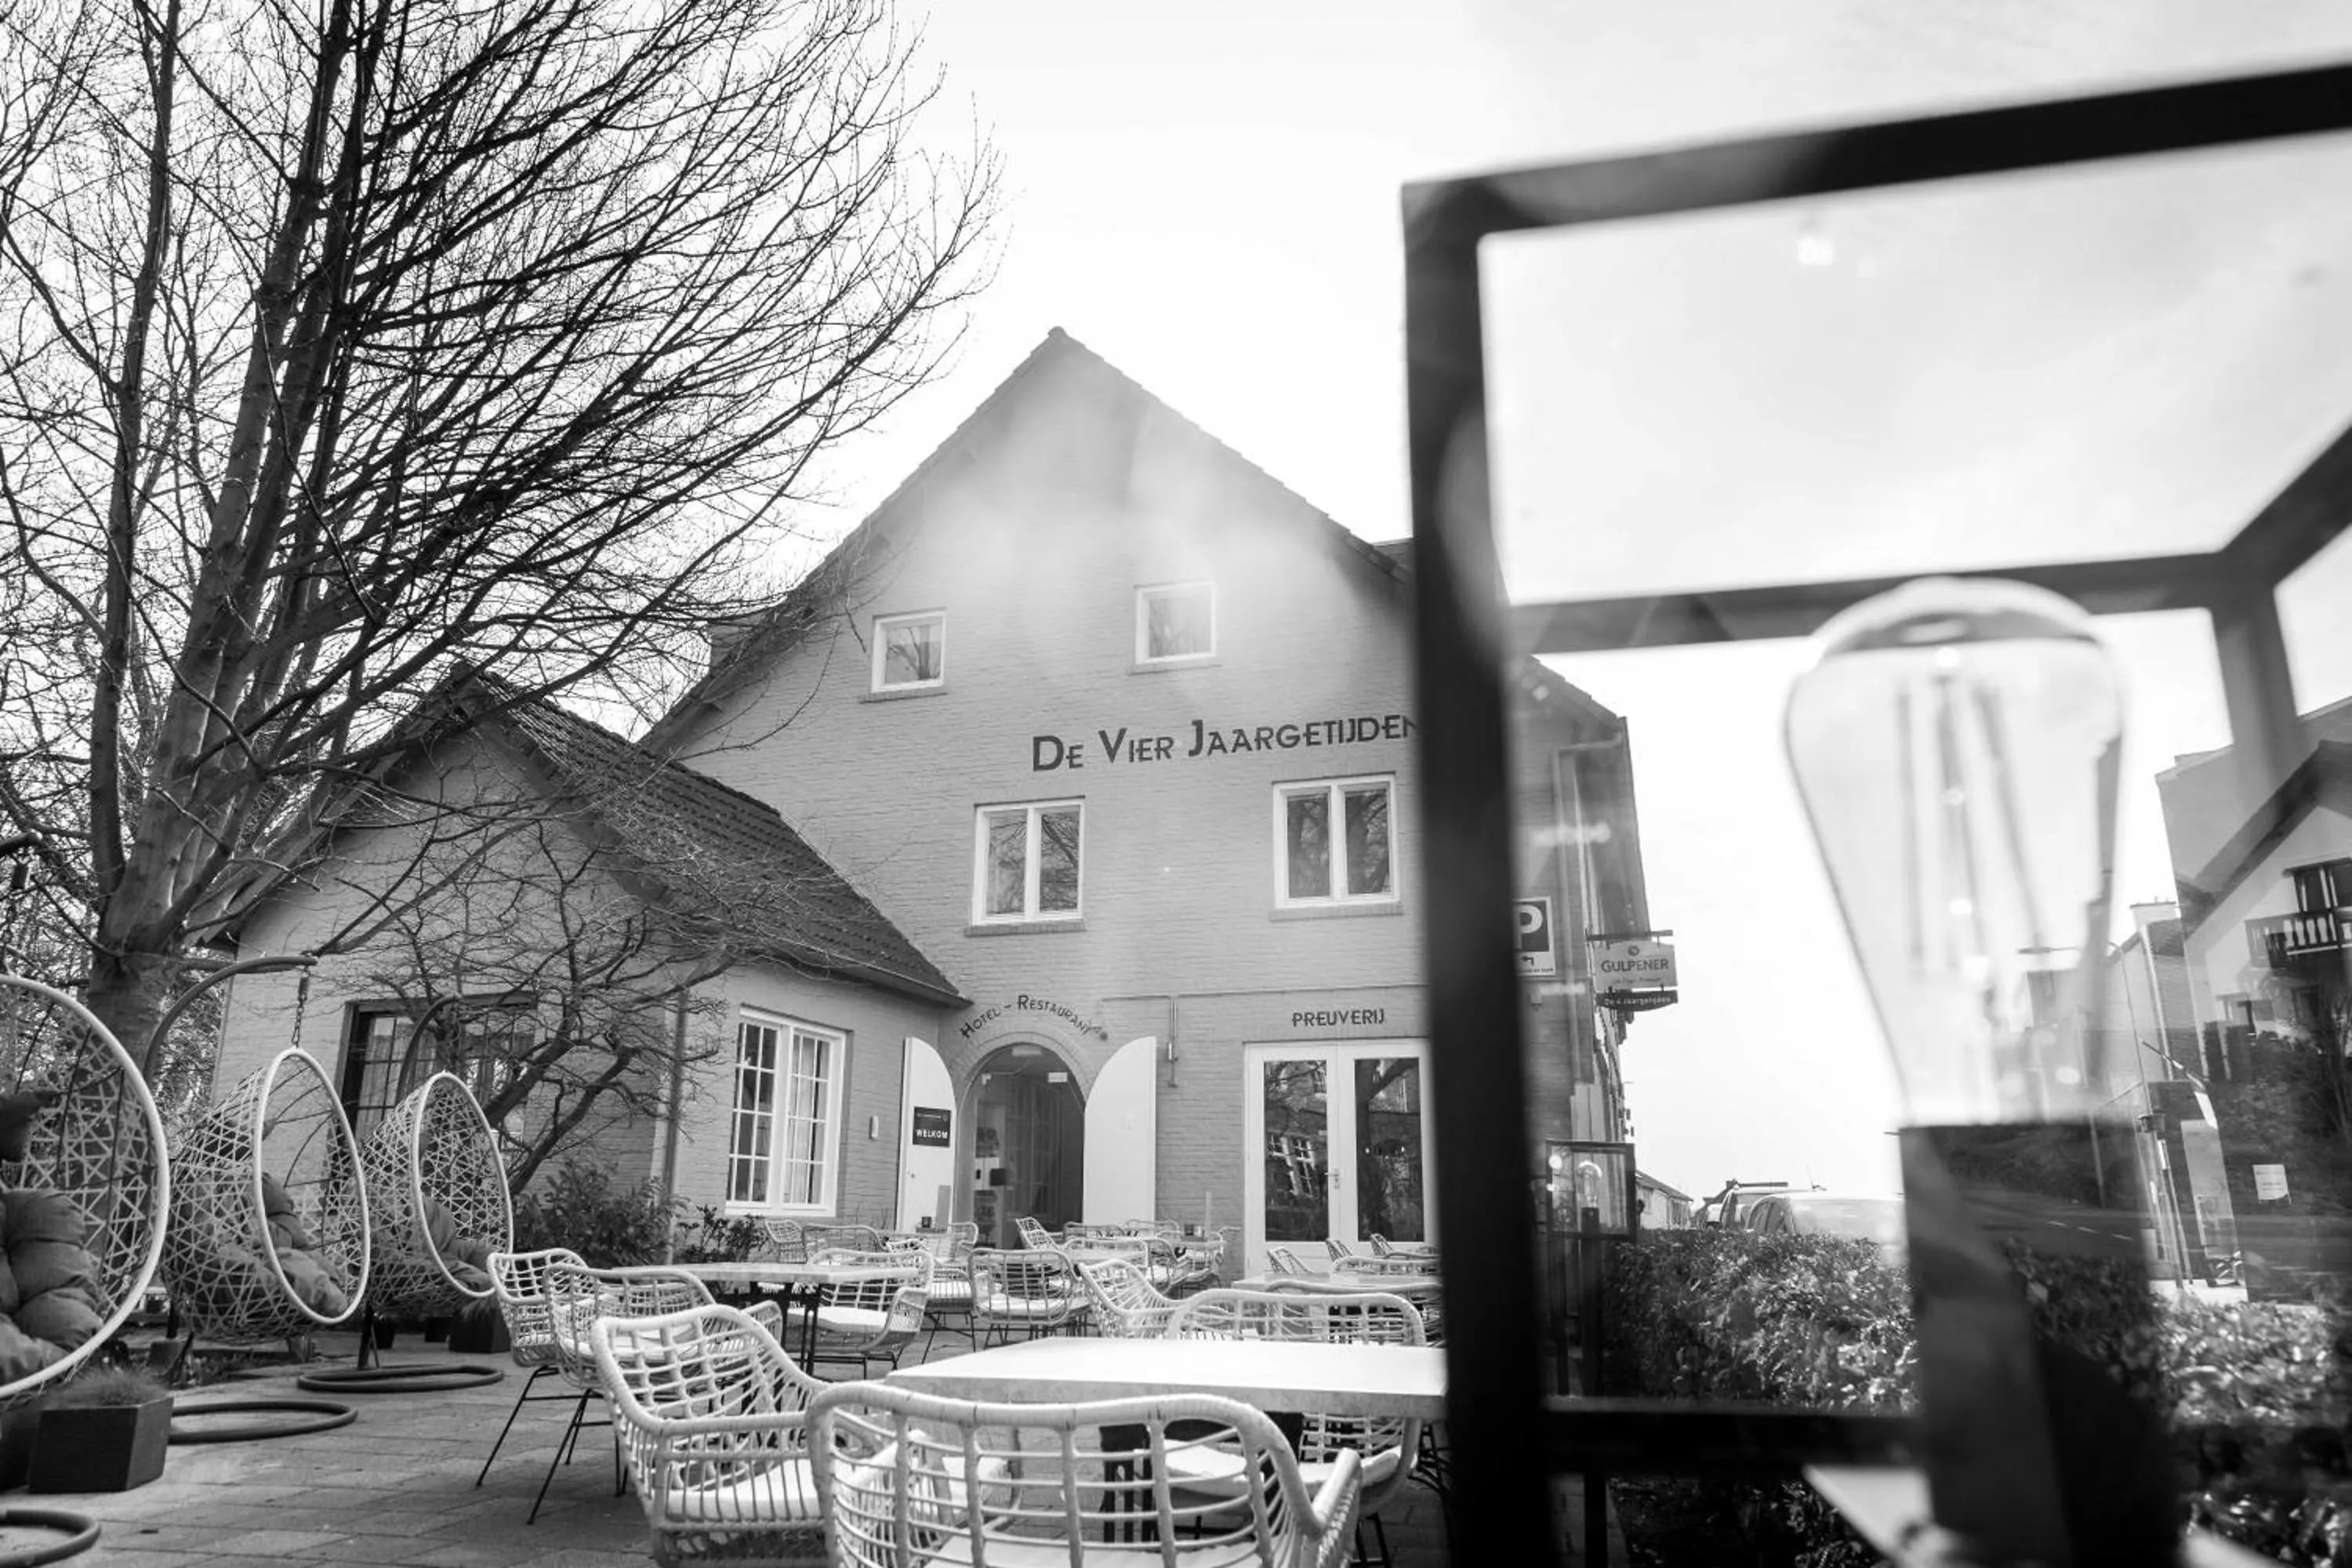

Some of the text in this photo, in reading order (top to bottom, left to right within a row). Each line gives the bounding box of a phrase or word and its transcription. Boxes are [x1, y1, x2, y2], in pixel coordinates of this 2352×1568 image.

[1514, 904, 1543, 949] P
[1601, 959, 1669, 972] GULPENER
[1292, 1008, 1385, 1028] PREUVERIJ
[916, 1129, 947, 1138] WELKOM
